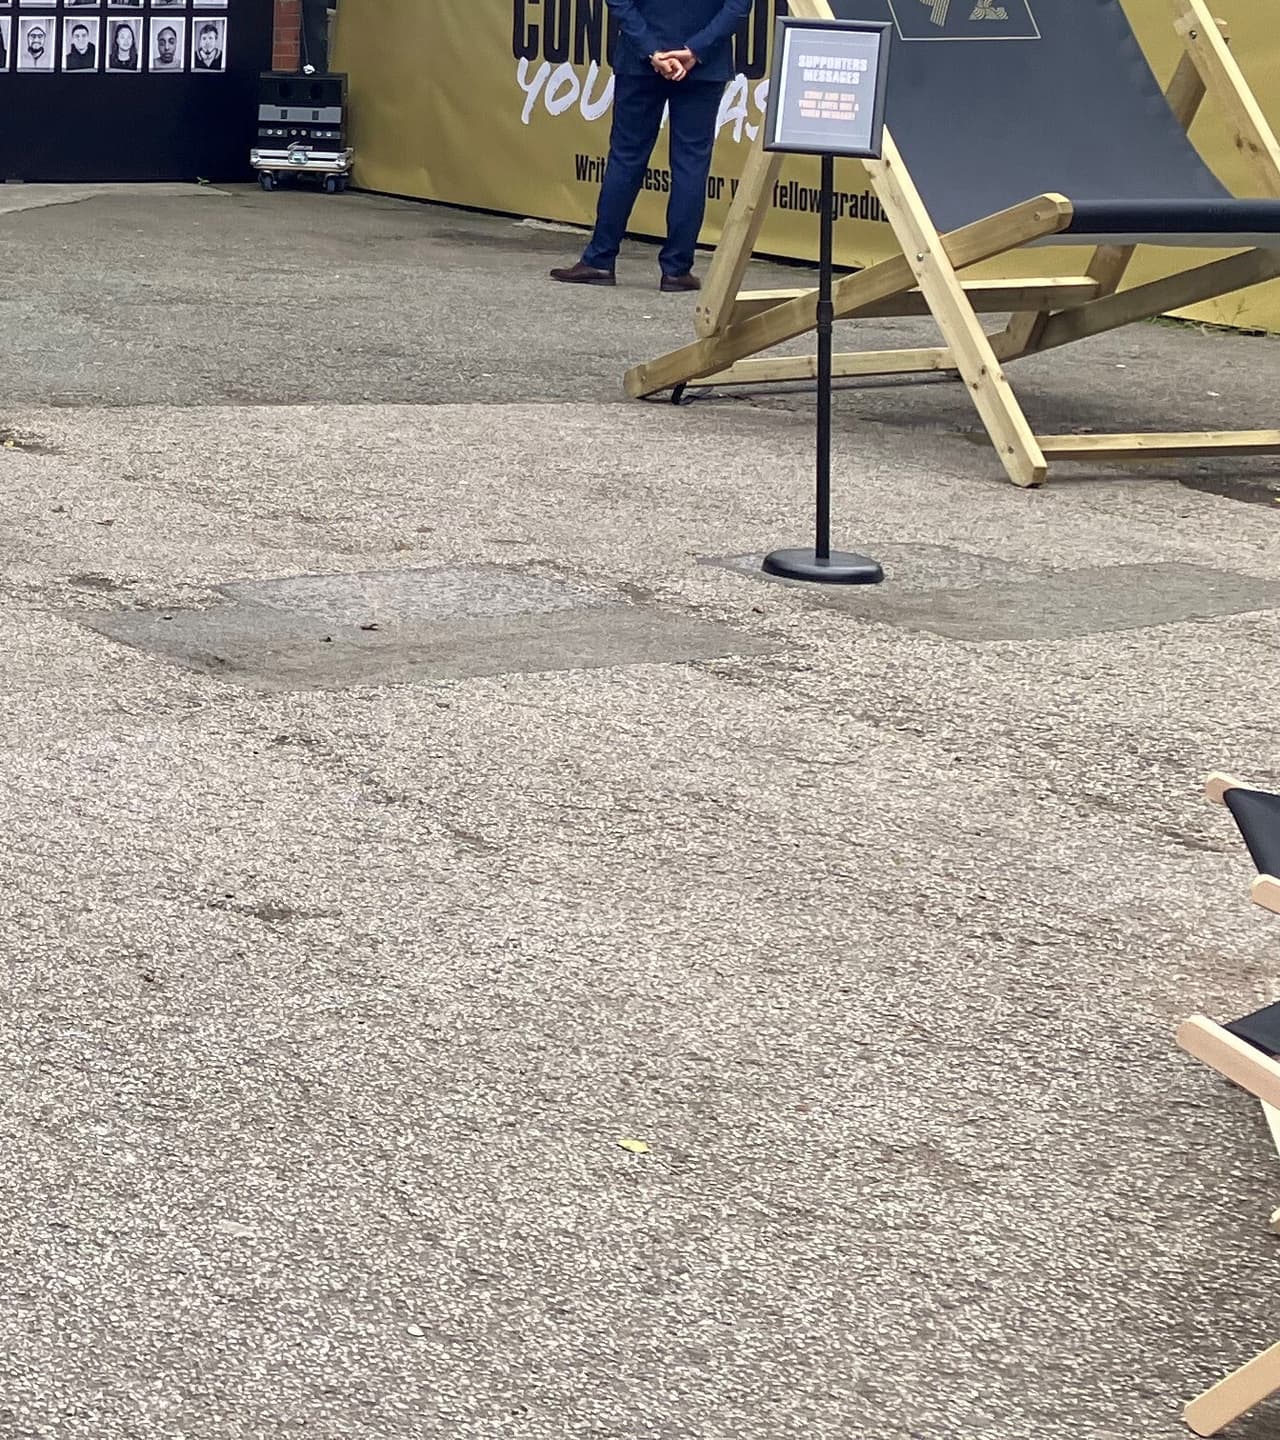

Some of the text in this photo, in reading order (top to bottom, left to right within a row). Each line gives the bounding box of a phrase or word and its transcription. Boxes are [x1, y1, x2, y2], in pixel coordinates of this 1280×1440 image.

[798, 55, 868, 71] SUPPORTERS
[803, 69, 860, 84] MESSAGES
[575, 154, 606, 183] Writ
[707, 175, 724, 200] or
[773, 179, 822, 214] fellow
